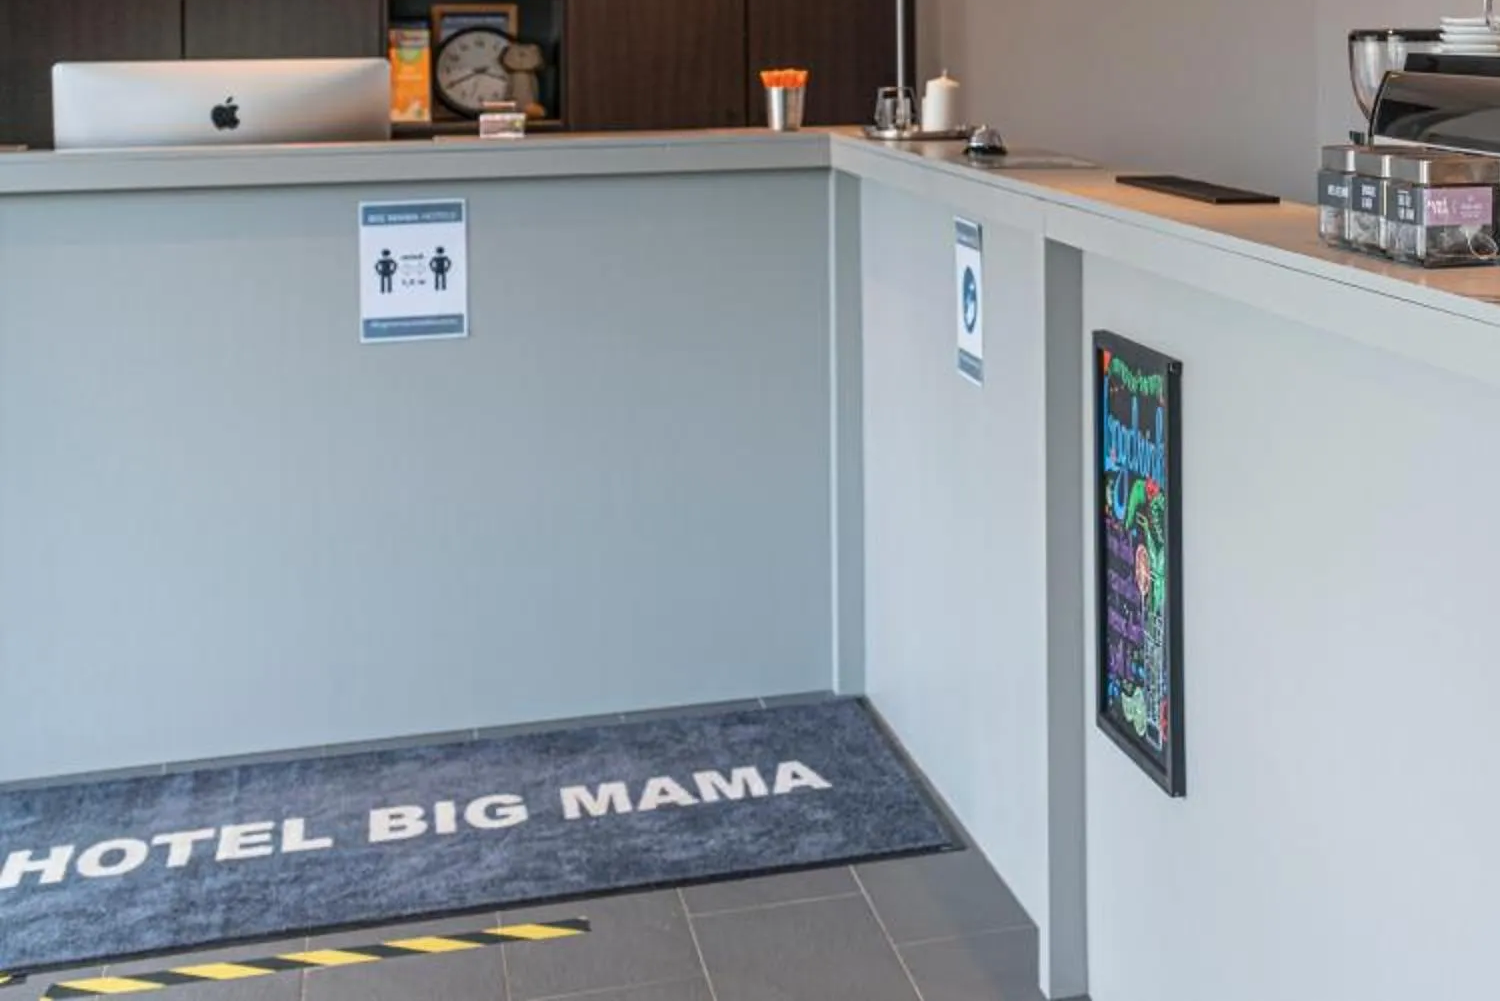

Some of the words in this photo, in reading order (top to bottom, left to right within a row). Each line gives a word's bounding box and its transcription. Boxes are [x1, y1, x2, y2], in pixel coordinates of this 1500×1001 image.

[0, 818, 334, 890] HOTEL
[368, 794, 529, 843] BIG
[559, 759, 833, 820] MAMA
